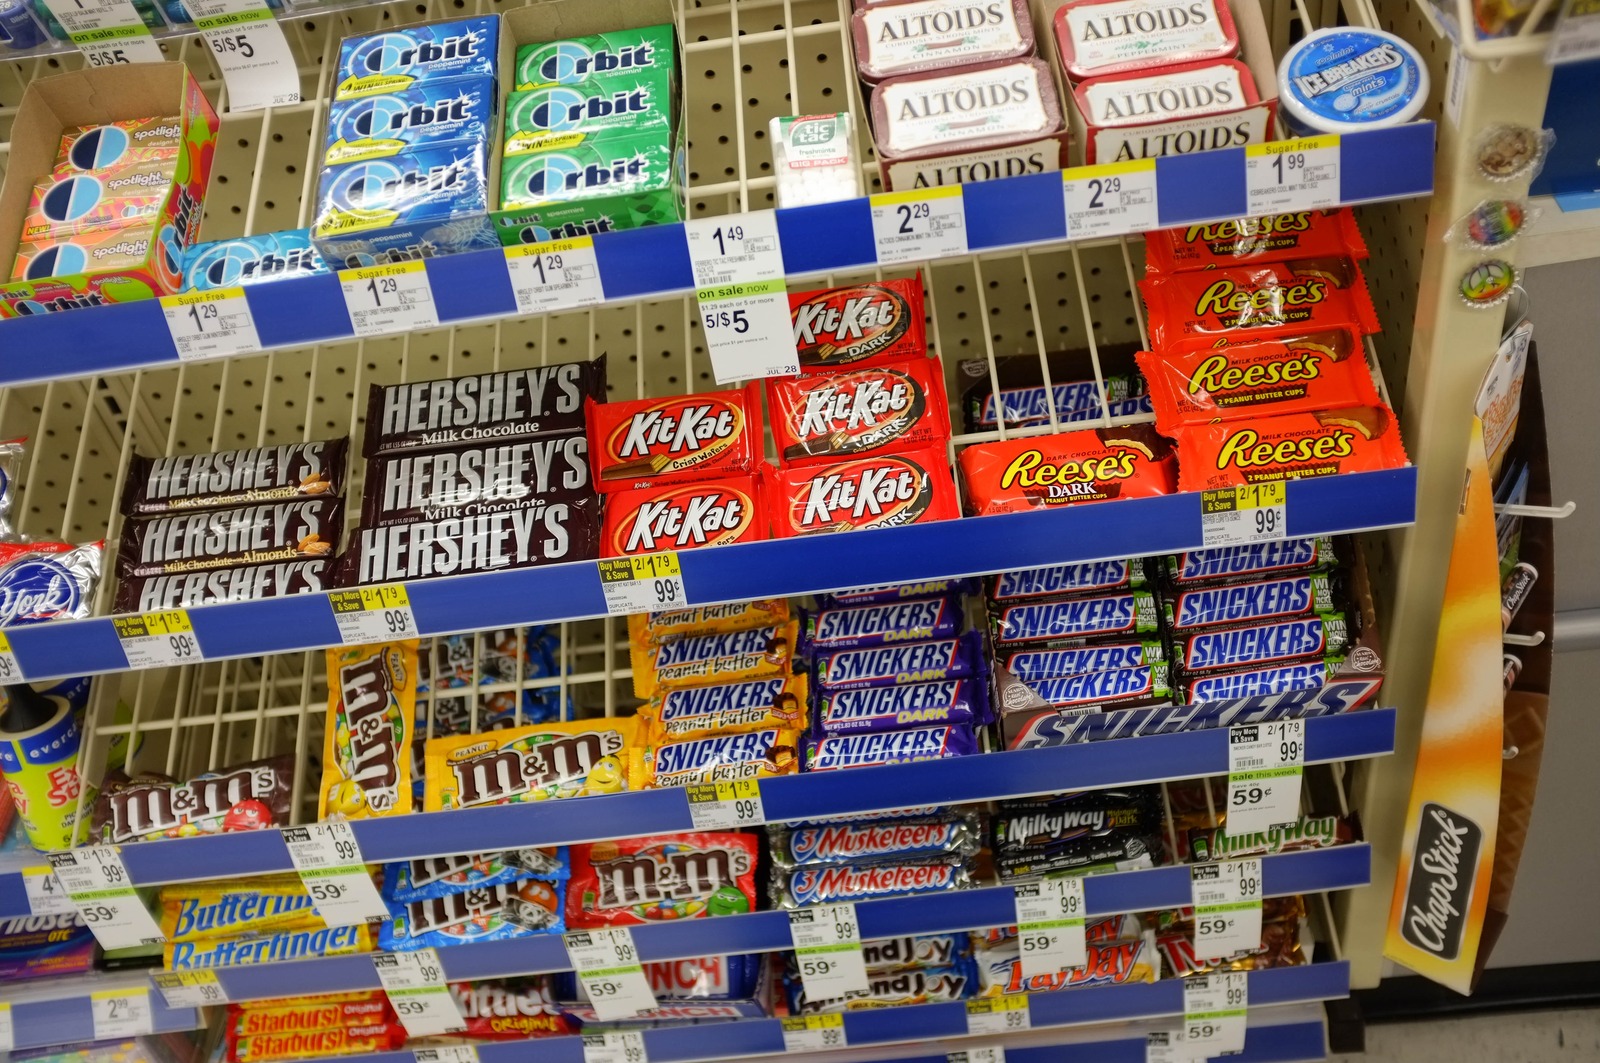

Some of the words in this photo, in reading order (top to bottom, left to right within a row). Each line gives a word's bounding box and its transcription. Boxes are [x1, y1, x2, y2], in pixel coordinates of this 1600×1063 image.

[199, 19, 213, 28] on
[214, 14, 238, 25] sale
[240, 11, 260, 21] now
[878, 3, 1004, 43] ALTOIDS
[1082, 2, 1209, 41] ALTOIDS
[74, 34, 89, 42] on
[91, 30, 113, 40] sale
[116, 27, 136, 36] now
[364, 34, 479, 74] Orbit
[539, 43, 654, 81] Orbit
[913, 44, 980, 59] CINNAMON
[1117, 44, 1187, 59] PEPPERMINT
[1315, 45, 1355, 65] coolmint
[428, 58, 471, 70] peppermint
[605, 68, 643, 78] spearmint
[1294, 73, 1327, 99] ICE
[1324, 43, 1398, 85] BREAKERS
[1351, 77, 1385, 97] mints
[532, 88, 651, 128] Orbit
[899, 79, 1029, 121] ALTOIDS
[1103, 81, 1233, 120] ALTOIDS
[354, 98, 472, 137] Orbit
[419, 122, 463, 133] peppermint
[601, 114, 637, 125] spearmint
[805, 123, 830, 133] tic
[799, 132, 829, 142] tac
[1116, 122, 1251, 162] ALTOIDS
[1265, 143, 1295, 155] Sugar
[1298, 140, 1319, 150] Free
[799, 147, 836, 155] freshmints
[814, 157, 846, 166] PACK
[108, 171, 162, 189] spotlight
[528, 157, 647, 198] Orbit
[499, 213, 541, 227] Orbit
[547, 207, 584, 217] spearmint
[26, 225, 50, 235] NEW!
[369, 231, 413, 244] peppermint
[93, 240, 148, 258] spotlight
[523, 247, 548, 256] Sugar
[551, 242, 573, 251] Free
[1277, 238, 1295, 247] CUPS
[357, 270, 382, 280] Sugar
[385, 266, 406, 275] Free
[177, 295, 202, 306] Sugar
[204, 292, 225, 301] Free
[699, 291, 714, 299] on
[718, 285, 743, 297] sale
[747, 284, 769, 292] now
[1195, 280, 1326, 317] Reese's
[1290, 311, 1309, 319] CUPS
[848, 332, 892, 356] DARK
[766, 368, 781, 376] JUL
[784, 365, 797, 373] 28
[1187, 353, 1323, 394] Reese's
[382, 364, 581, 437] HERSHEY'S
[1224, 395, 1253, 404] PEANUT
[1255, 391, 1284, 400] BUTTER
[1285, 388, 1304, 396] CUPS
[421, 431, 459, 446] Milk
[461, 422, 539, 440] Chocolate
[862, 418, 907, 444] DARK
[1284, 428, 1331, 438] CHOCOLATE
[672, 457, 698, 469] Crisp
[699, 442, 728, 460] Wafers
[1071, 448, 1116, 458] CHOCOLATE
[1217, 429, 1354, 470] Reese's
[146, 441, 324, 500] HERSHEY'S
[383, 436, 587, 512] HERSHEY'S
[1000, 449, 1136, 490] Reese's
[1255, 471, 1284, 480] PEANUT
[1286, 469, 1315, 477] BUTTER
[1317, 466, 1337, 474] CUPS
[1048, 482, 1097, 498] DARK
[1203, 492, 1216, 502] Buy
[1218, 490, 1235, 498] More
[425, 507, 461, 520] Milk
[141, 500, 323, 564] HERSHEY'S
[359, 503, 568, 584] HERSHEY'S
[600, 562, 613, 571] Buy
[614, 560, 630, 569] More
[1185, 540, 1313, 577] SNICKERS
[138, 560, 325, 610] HERSHEY'S
[899, 581, 948, 596] DARK
[998, 558, 1129, 597] SNICKERS
[2, 575, 62, 623] York
[329, 592, 340, 602] Buy
[342, 591, 361, 602] More
[1182, 578, 1312, 625] SNICKERS
[1506, 572, 1532, 611] ChapStick
[114, 619, 126, 628] Buy
[127, 617, 144, 626] More
[821, 601, 939, 639] SNICKERS
[1002, 596, 1135, 640] SNICKERS
[883, 627, 933, 641] DARK
[1192, 620, 1322, 667] SNICKERS
[659, 626, 775, 667] SNICKERS
[832, 641, 954, 681] SNICKERS
[1012, 646, 1143, 680] SNICKERS
[896, 667, 947, 683] DARK
[664, 679, 783, 719] SNICKERS
[833, 681, 954, 719] SNICKERS
[897, 706, 949, 723] DARK
[341, 655, 399, 811] m&m's
[1232, 729, 1242, 737] Buy
[454, 744, 489, 758] PEANUT
[657, 731, 775, 772] SNICKERS
[821, 728, 945, 767] SNICKERS
[457, 732, 623, 805] m&m's
[1232, 773, 1253, 781] sale
[685, 786, 698, 794] Buy
[700, 784, 715, 793] More
[111, 767, 274, 843] m&m's
[796, 828, 817, 852] 3
[818, 823, 948, 856] Musketeers
[599, 849, 748, 909] m&m's
[796, 869, 817, 894] 3
[819, 863, 951, 898] Musketeers
[1408, 809, 1469, 954] ChapStick
[173, 926, 359, 969] Butterfinger
[247, 1004, 338, 1033] Starburst
[344, 1003, 384, 1014] Original
[349, 1024, 387, 1037] Original
[251, 1028, 346, 1059] Starburst
